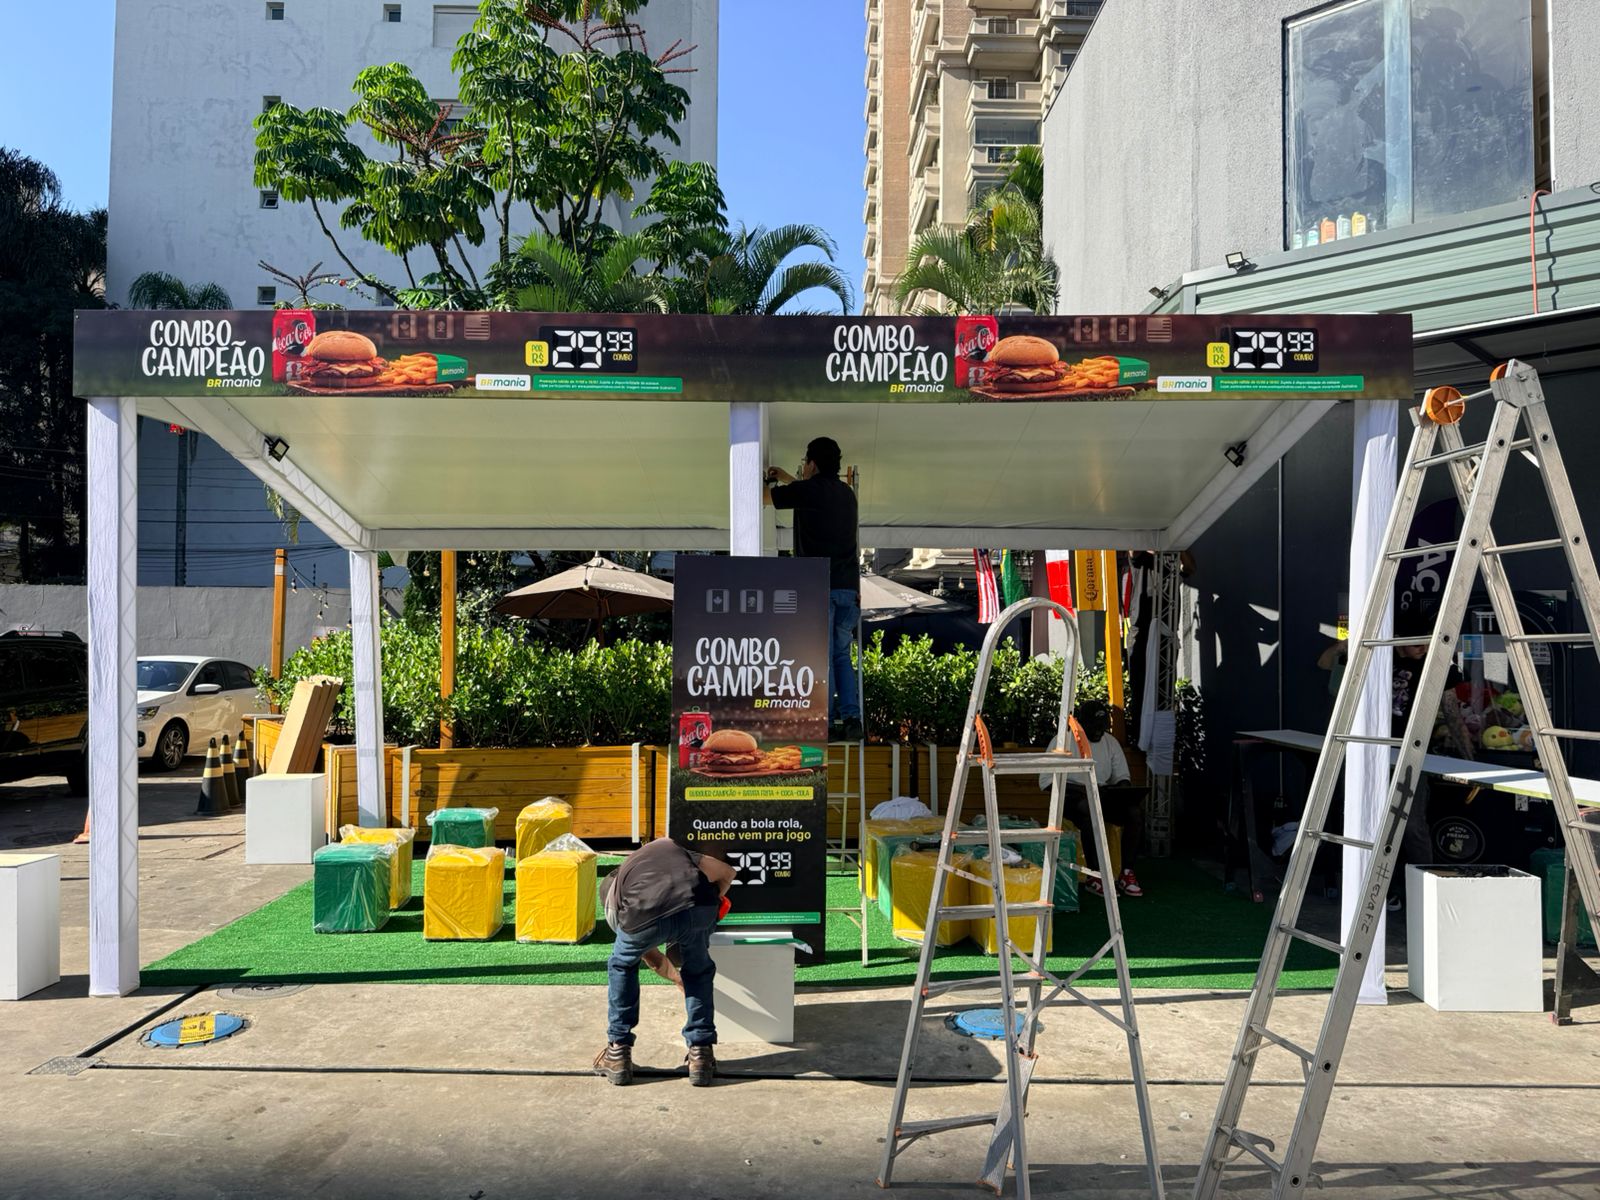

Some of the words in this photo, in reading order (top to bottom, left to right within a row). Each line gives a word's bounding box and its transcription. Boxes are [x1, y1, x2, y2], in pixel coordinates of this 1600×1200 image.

[151, 319, 232, 347] COMBO
[833, 324, 915, 352] COMBO
[141, 339, 265, 377] CAMPEÃO
[531, 353, 544, 364] R$
[612, 353, 633, 361] COMBO
[1212, 354, 1225, 365] R$
[1293, 353, 1314, 361] COMBO
[825, 345, 948, 383] CAMPEÃO
[206, 376, 262, 388] BRmania
[480, 377, 526, 387] BRmania
[889, 382, 944, 393] BRmania
[1161, 379, 1208, 389] BRmania
[695, 637, 780, 666] COMBO
[687, 659, 814, 697] CAMPEÃO
[754, 697, 811, 709] BRmania
[692, 818, 738, 830] Quando
[740, 820, 748, 829] a
[751, 818, 775, 829] bola
[778, 818, 803, 830] rola,
[697, 830, 736, 841] lanche
[738, 832, 762, 840] vem
[764, 832, 784, 842] pra
[785, 829, 812, 842] jogo
[774, 870, 792, 878] COMBO
